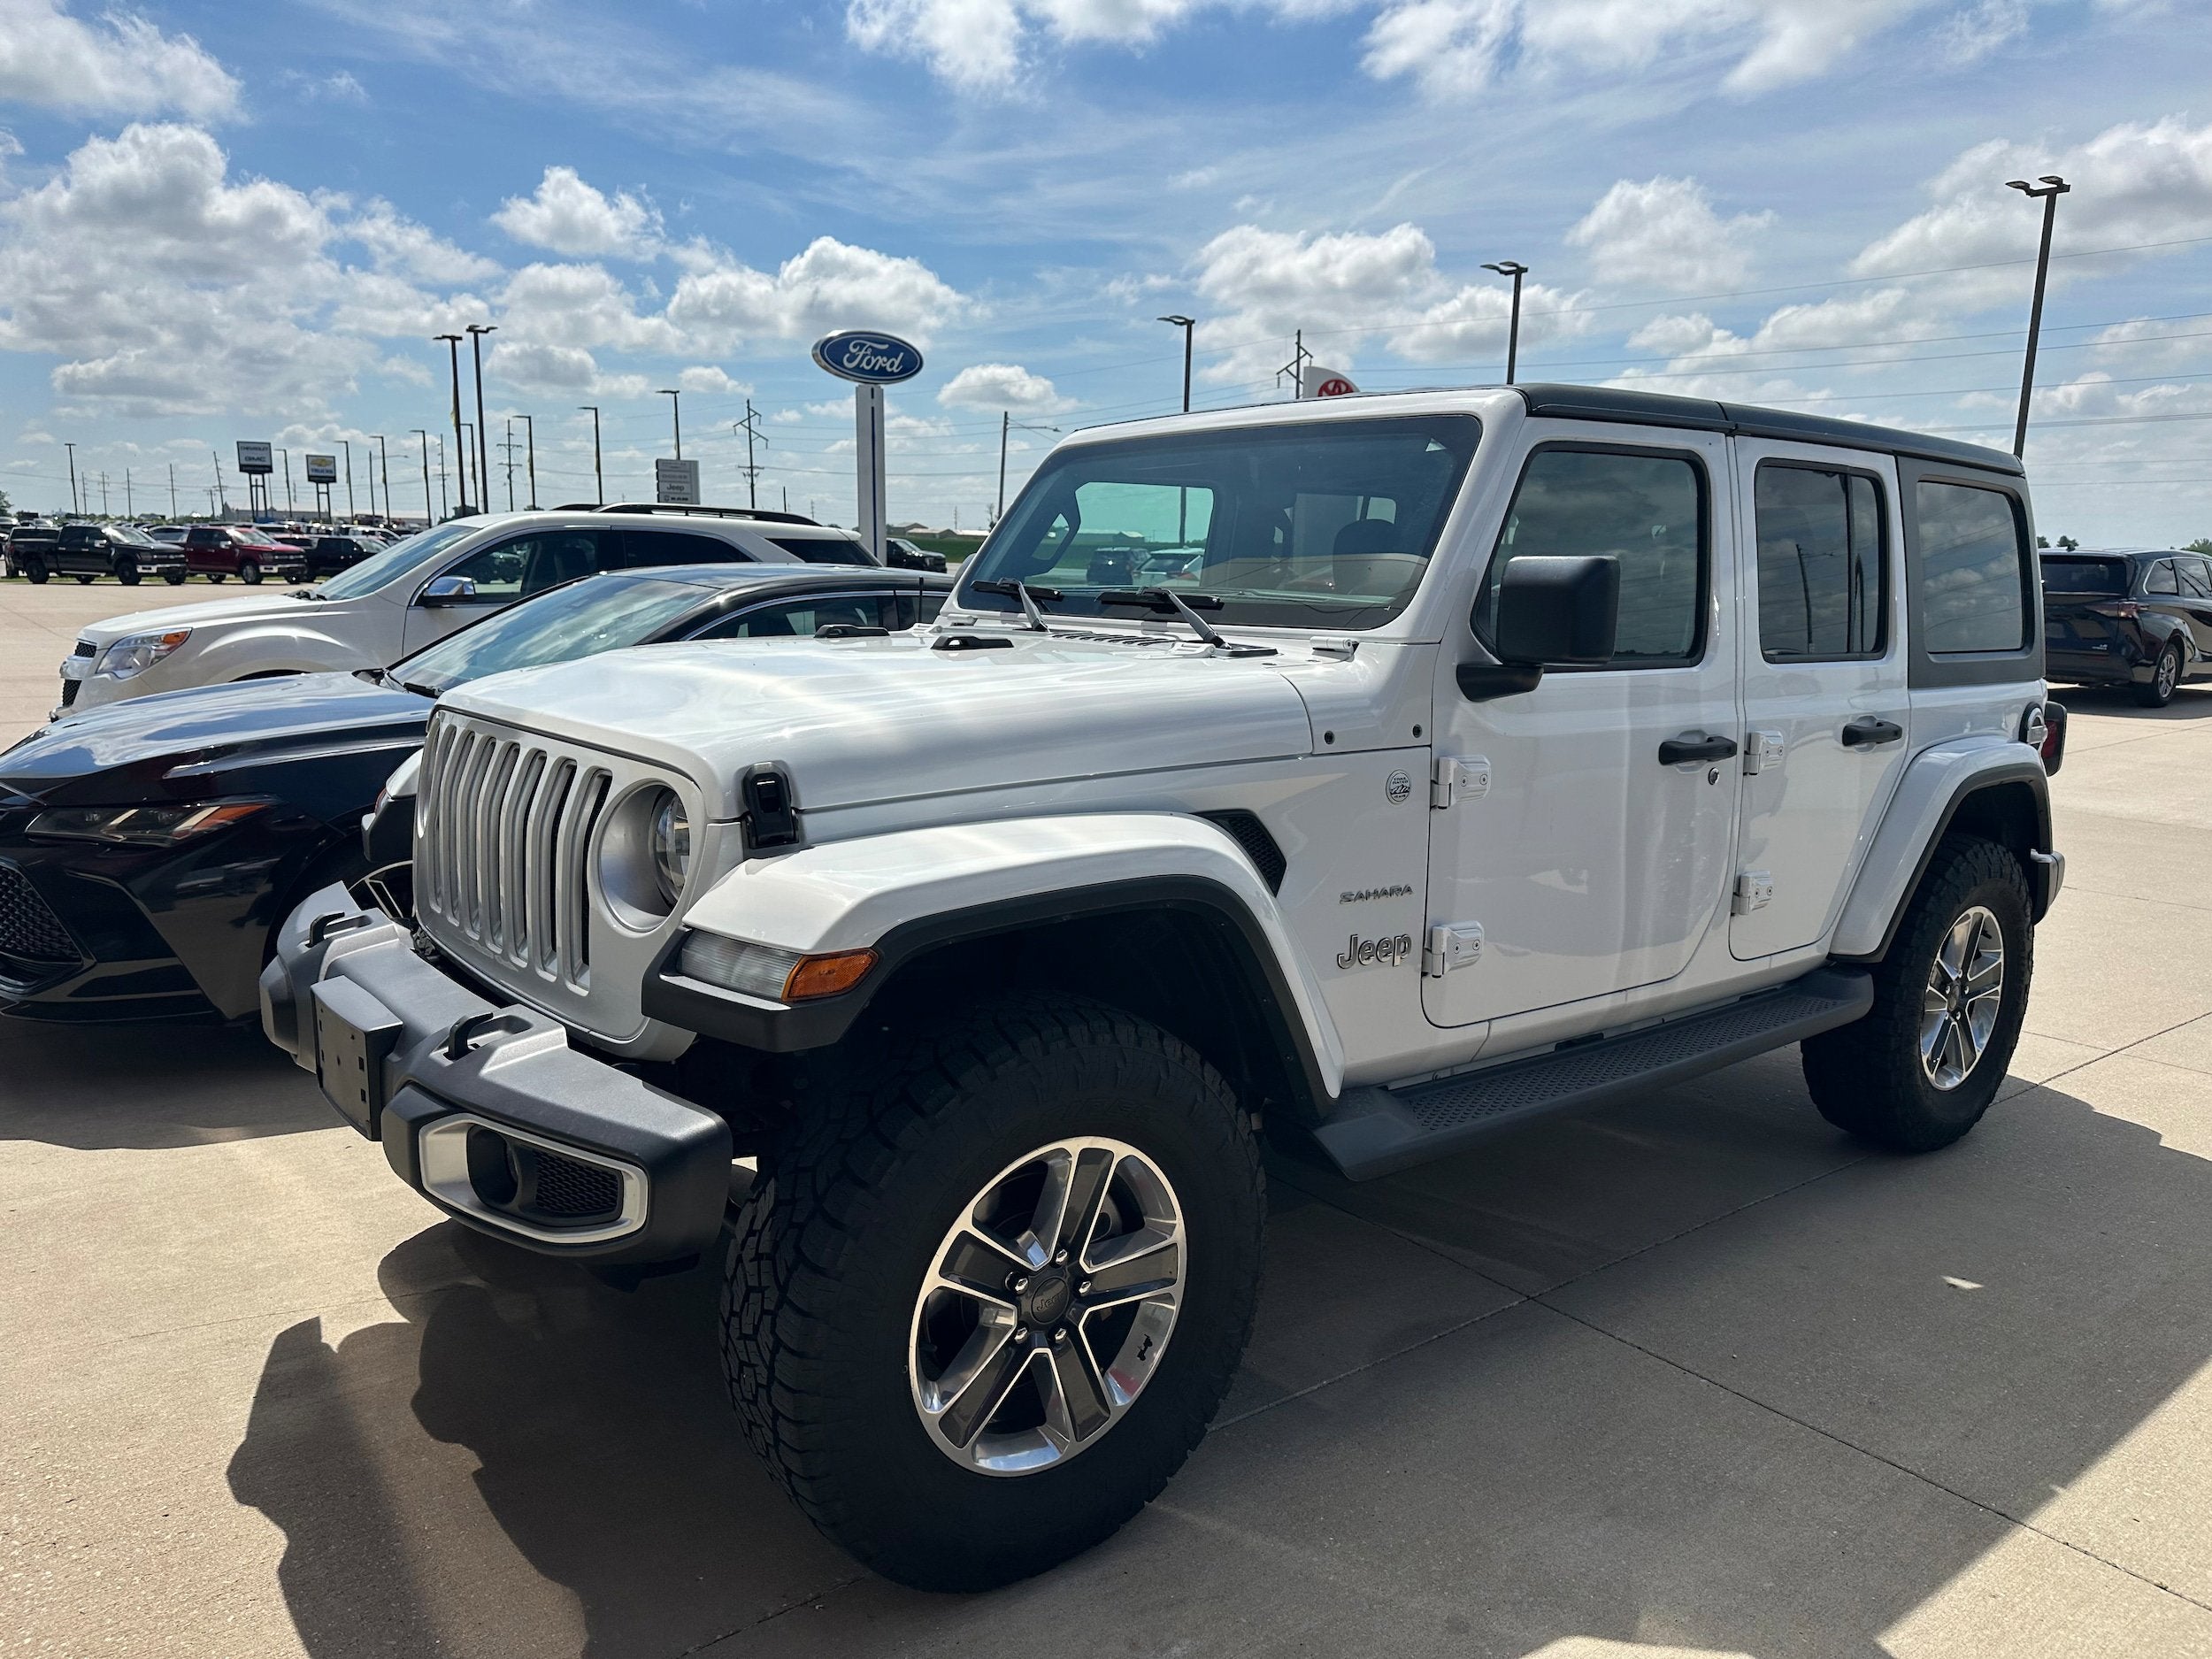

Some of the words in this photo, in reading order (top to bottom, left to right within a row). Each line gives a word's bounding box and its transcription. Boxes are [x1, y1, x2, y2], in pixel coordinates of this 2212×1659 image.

[842, 339, 904, 373] Ford
[666, 483, 685, 492] Jeep
[1339, 884, 1413, 904] SAHARA
[1337, 933, 1412, 970] Jeep
